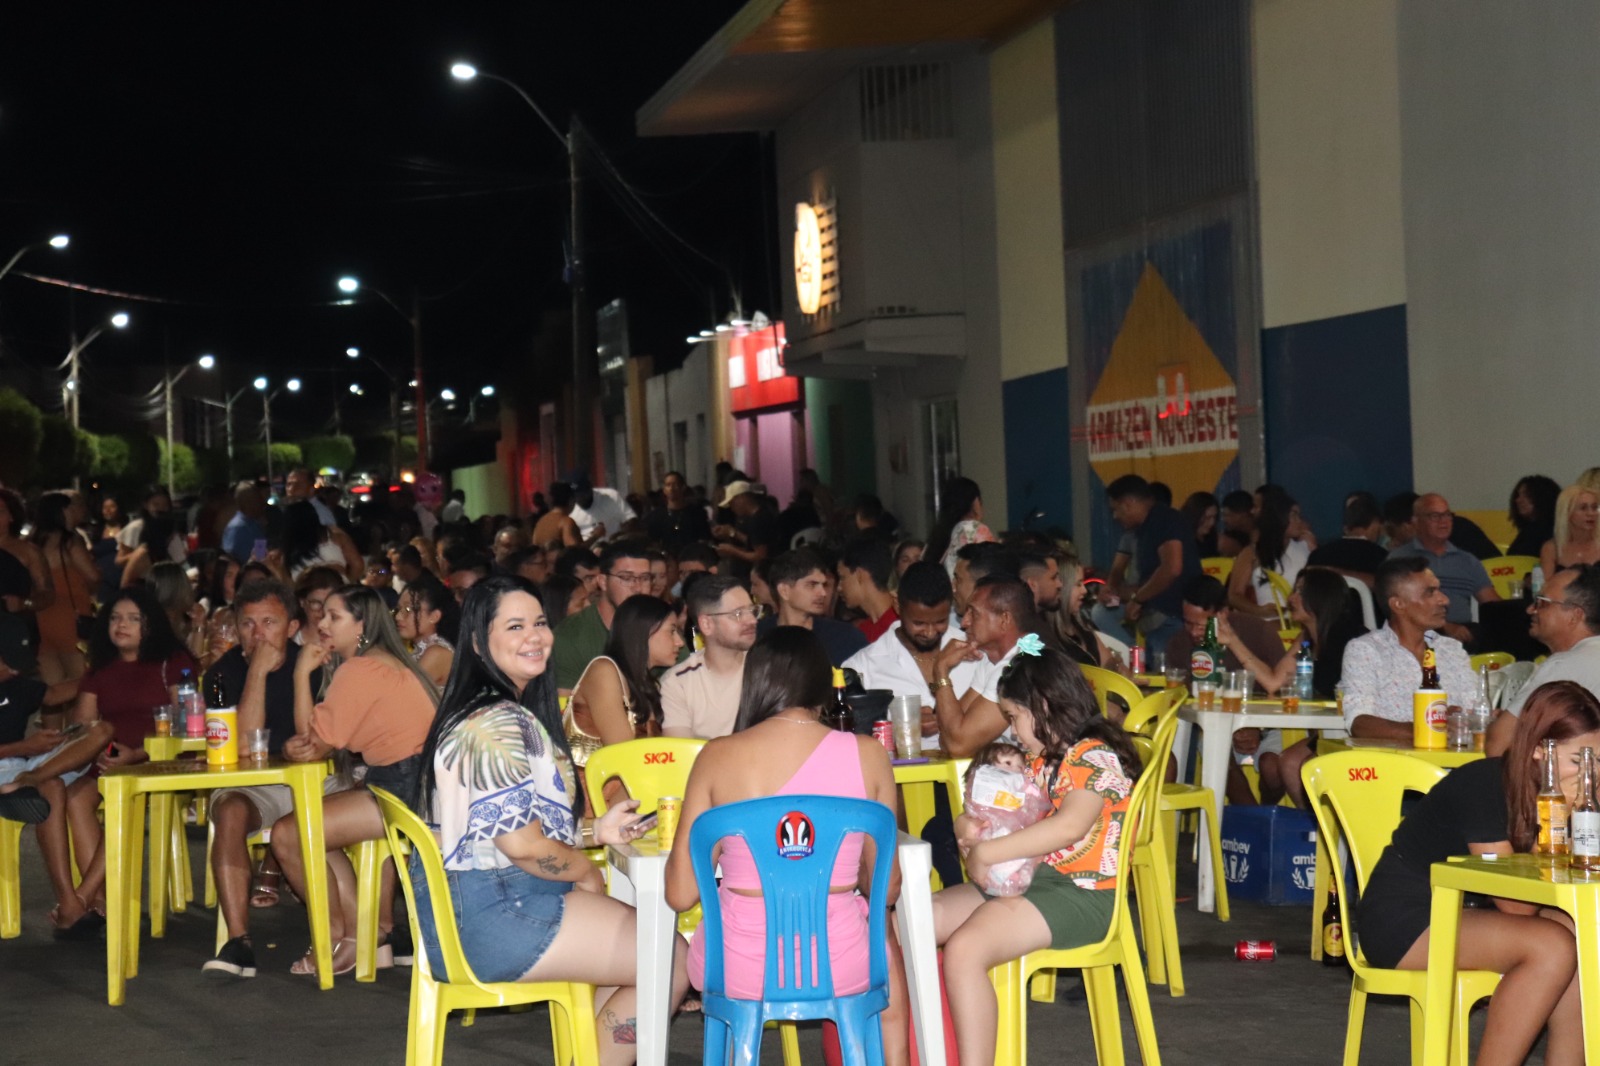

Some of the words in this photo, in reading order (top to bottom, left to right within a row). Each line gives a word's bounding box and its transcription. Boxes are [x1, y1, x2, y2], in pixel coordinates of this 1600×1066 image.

[644, 751, 676, 765] SKOL
[1348, 766, 1379, 782] SKOL
[1221, 838, 1251, 855] ambev
[1292, 853, 1317, 865] amb
